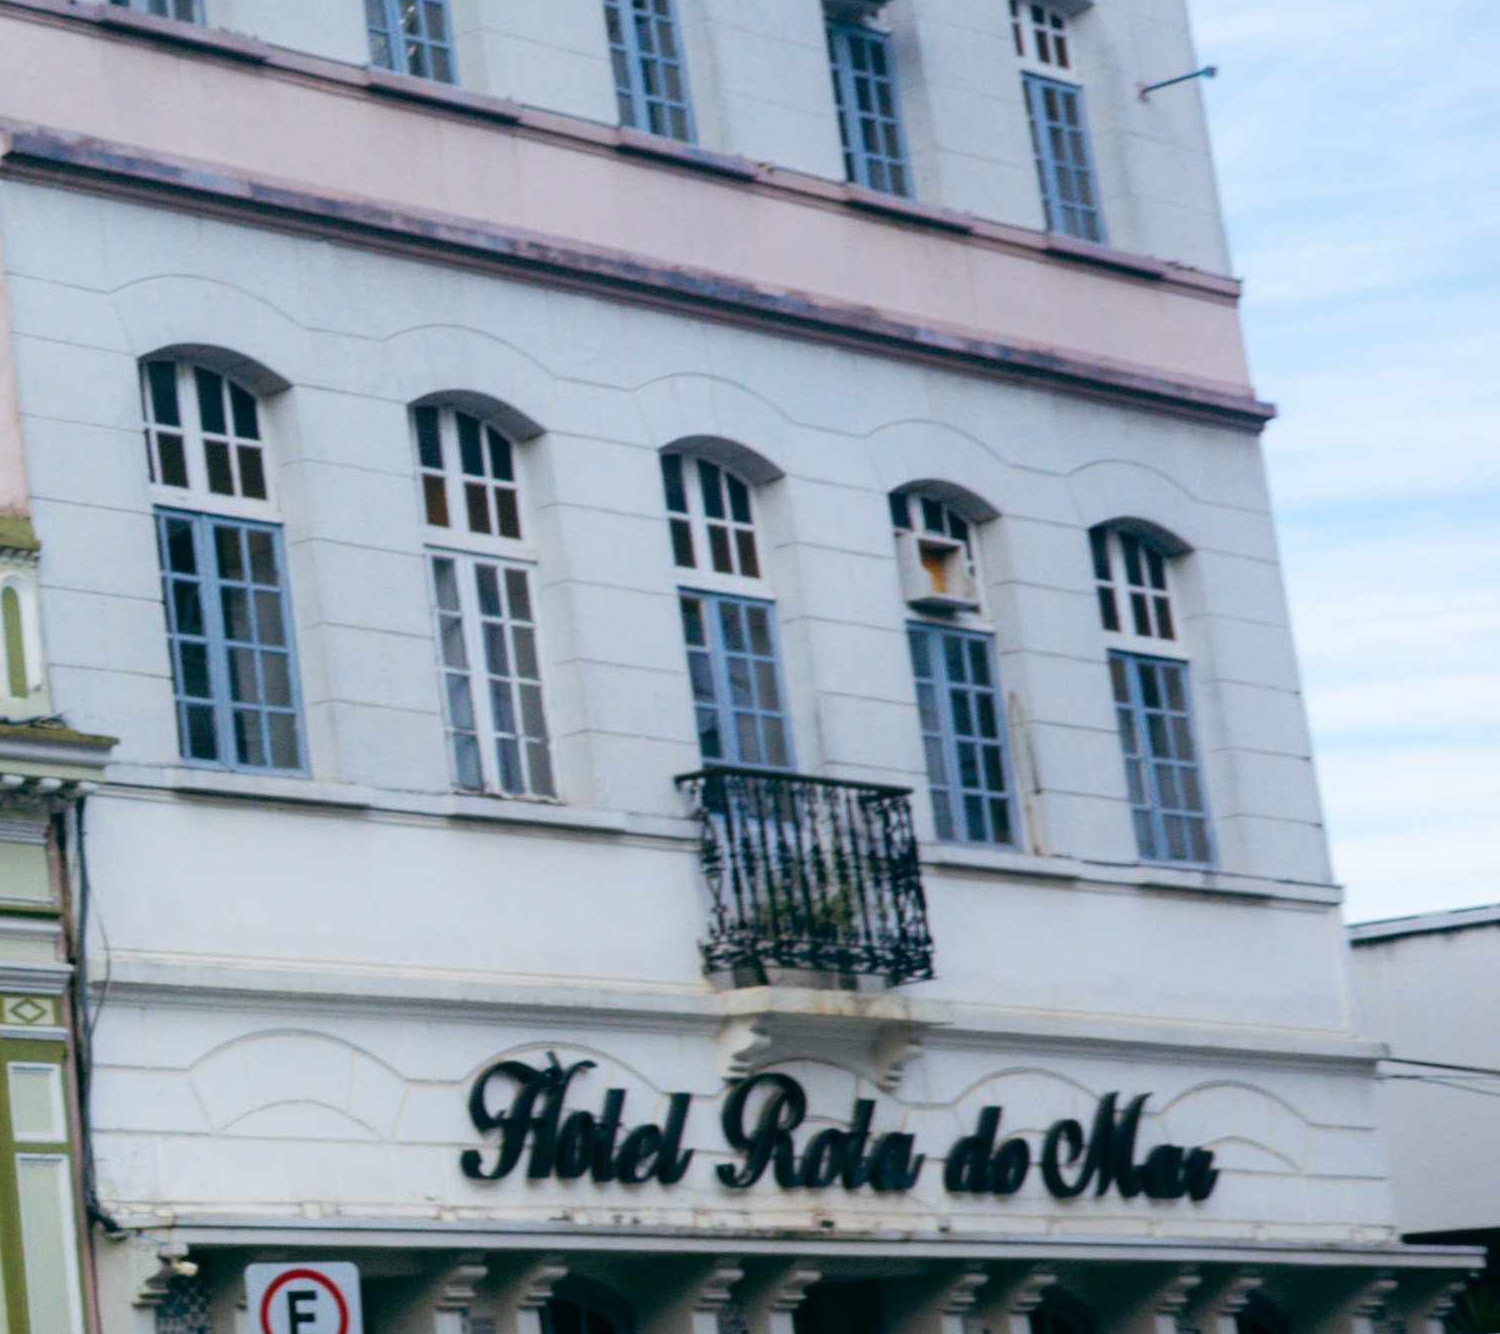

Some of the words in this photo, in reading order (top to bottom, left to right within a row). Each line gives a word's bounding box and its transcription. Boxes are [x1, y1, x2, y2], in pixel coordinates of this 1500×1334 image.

[460, 1051, 695, 1186] Hotel
[716, 1070, 925, 1195] Rota
[944, 1105, 1030, 1197] do
[1039, 1091, 1220, 1202] Mar
